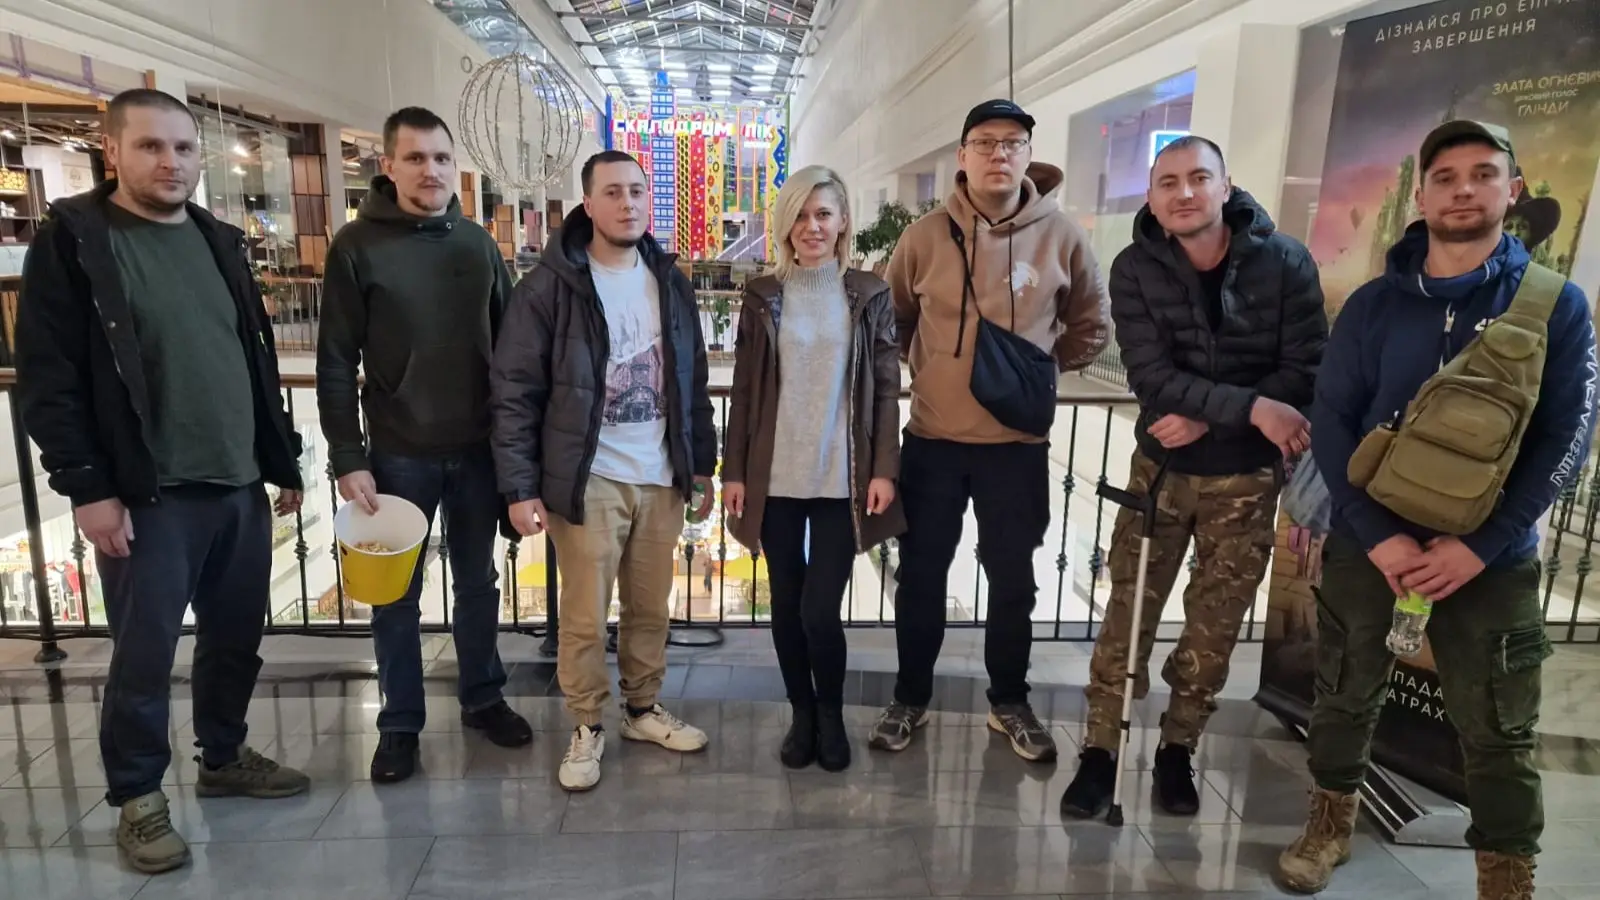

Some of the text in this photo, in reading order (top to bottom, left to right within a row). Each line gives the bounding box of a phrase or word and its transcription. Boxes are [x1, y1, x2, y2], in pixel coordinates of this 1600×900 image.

[1375, 12, 1461, 43] ДІЗНАЙСЯ
[1470, 3, 1508, 21] ПРО
[1412, 18, 1536, 54] ЗАВЕРШЕННЯ
[1492, 78, 1533, 95] ЗЛАТА
[612, 119, 730, 137] СКАЛОДРОМ
[1394, 670, 1444, 701] ПАДА
[1387, 688, 1445, 722] АТРАХ
